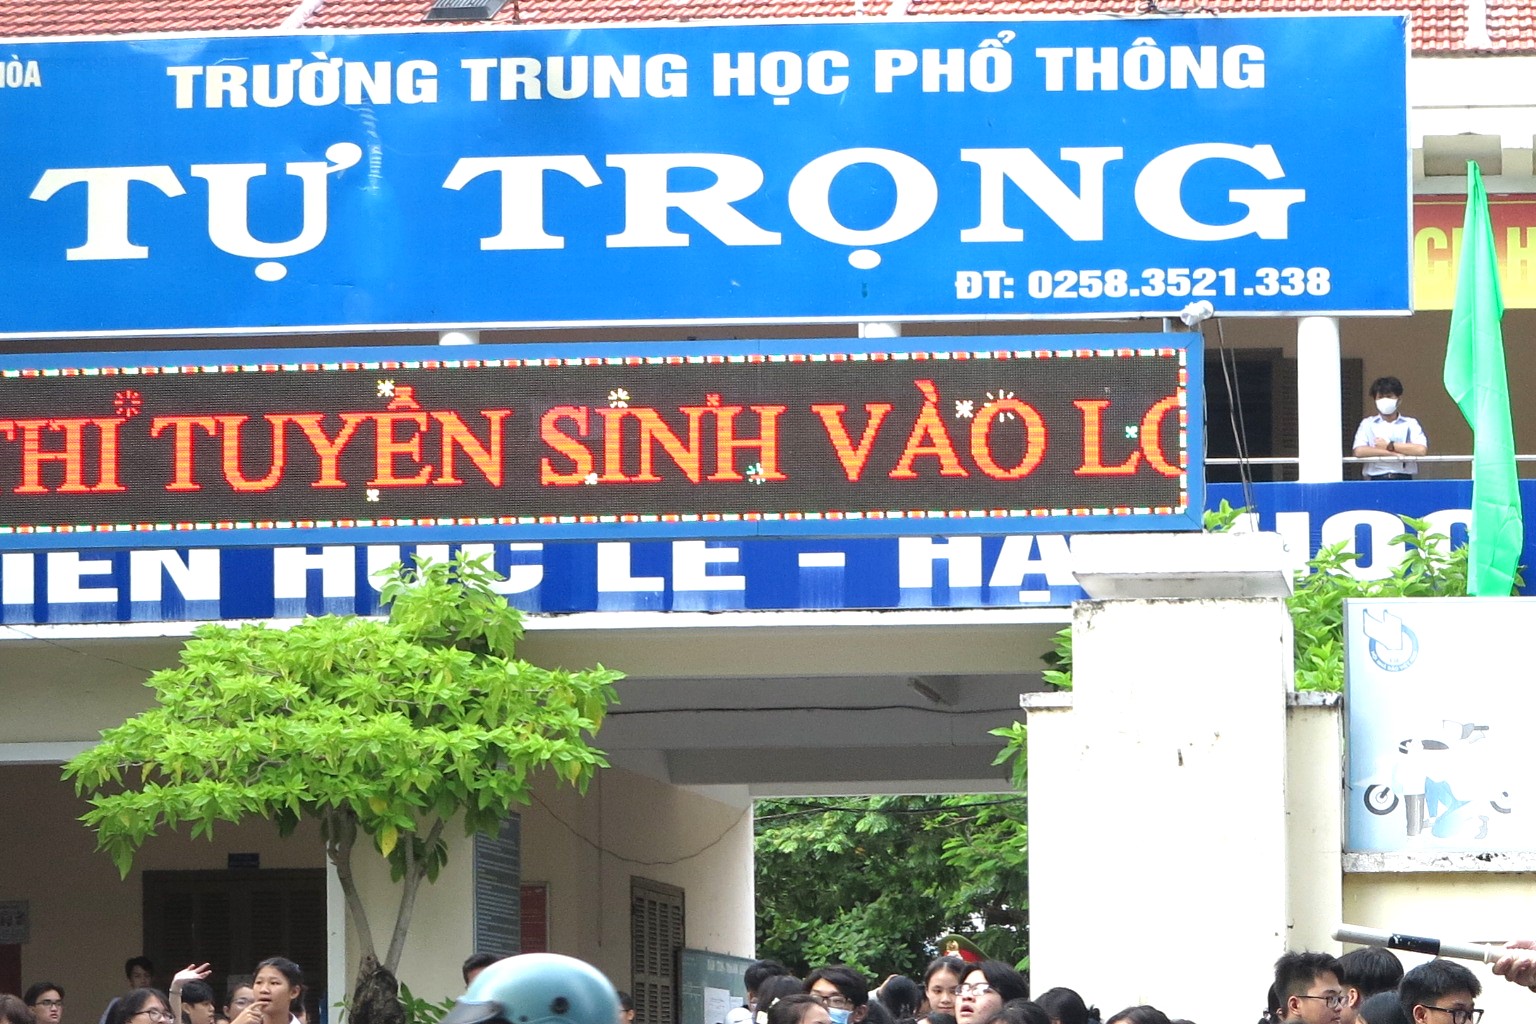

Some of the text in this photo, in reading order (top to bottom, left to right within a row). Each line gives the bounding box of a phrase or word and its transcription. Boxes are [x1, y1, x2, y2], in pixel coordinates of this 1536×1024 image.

[167, 30, 1266, 109] TRƯỜNG TRUNG HỌC PHỔ THÔNG
[30, 142, 1306, 282] TỰ TRỌNG
[955, 266, 1331, 300] ĐT: 0258.3521.338
[0, 417, 128, 494] HI
[540, 403, 788, 486] SINH
[811, 381, 1048, 482] VÀO
